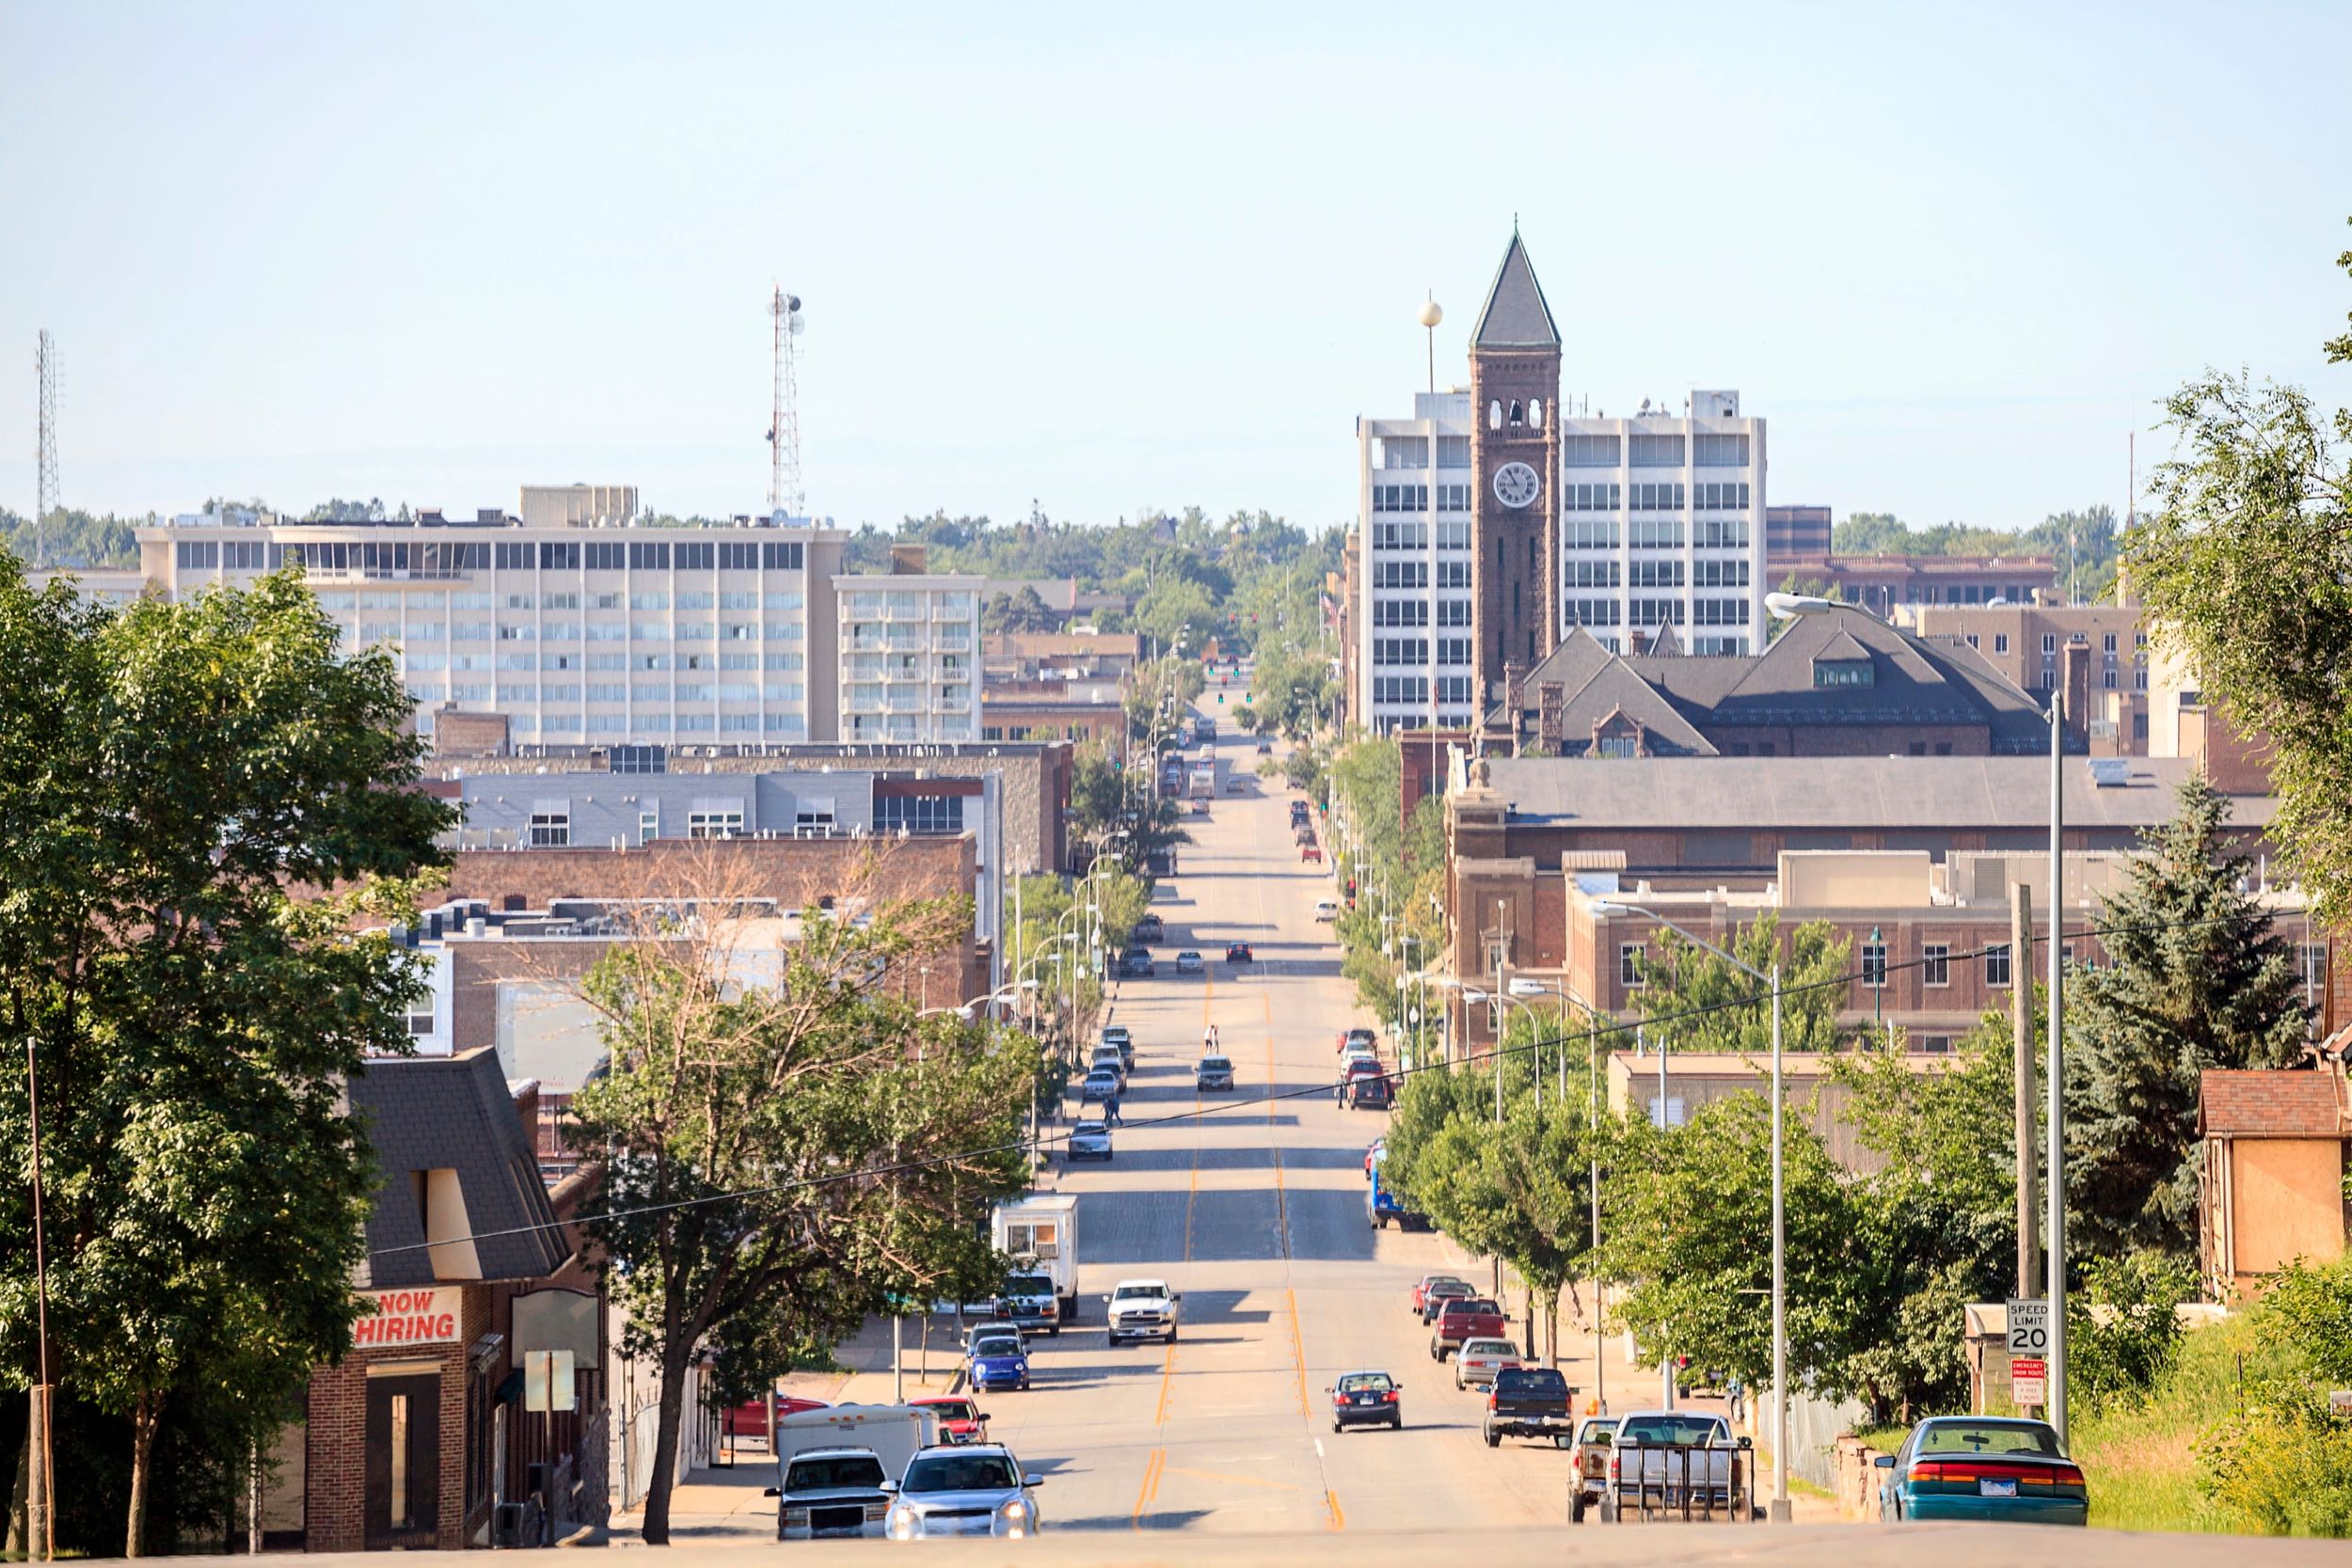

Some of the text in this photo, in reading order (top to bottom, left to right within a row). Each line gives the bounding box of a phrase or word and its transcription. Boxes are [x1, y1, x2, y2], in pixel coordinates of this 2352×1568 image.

[379, 1291, 435, 1314] NOW
[2010, 1306, 2048, 1315] SPEED
[355, 1313, 454, 1344] HIRING
[2014, 1317, 2043, 1326] LIMIT
[2012, 1328, 2046, 1348] 20
